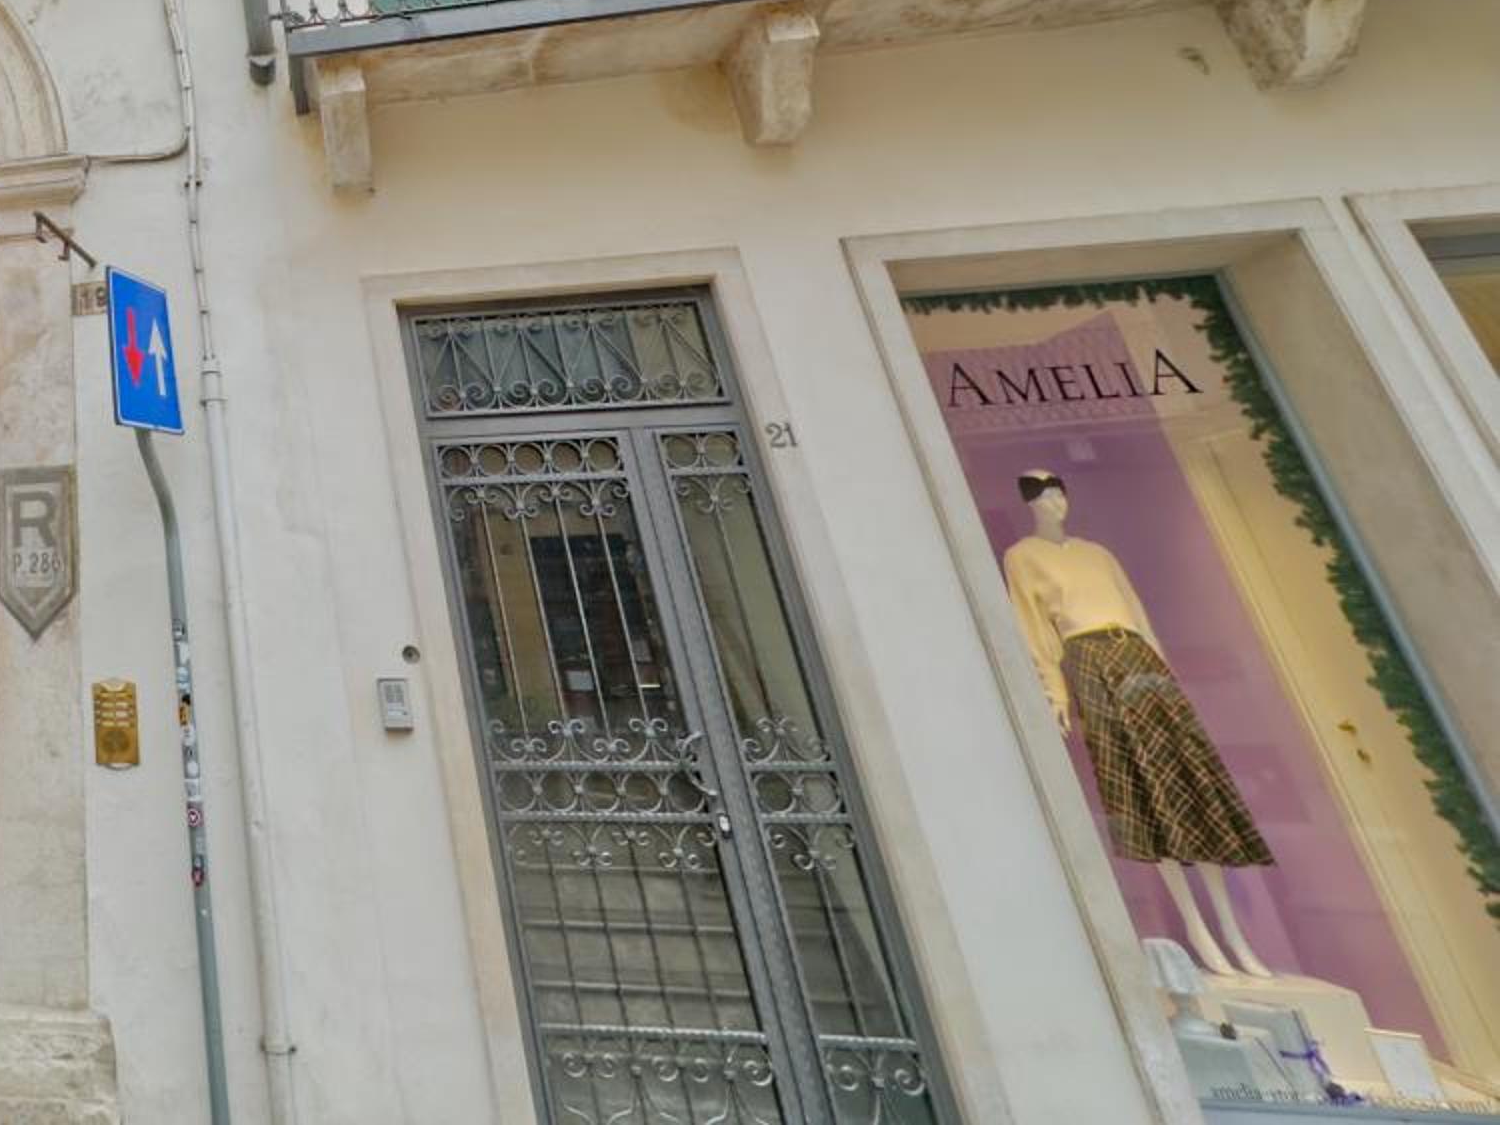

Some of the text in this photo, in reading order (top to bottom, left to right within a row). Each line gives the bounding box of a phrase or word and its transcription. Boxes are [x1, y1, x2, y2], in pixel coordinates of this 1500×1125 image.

[947, 348, 1203, 407] AMELIA
[766, 422, 799, 448] 21
[13, 491, 57, 548] R
